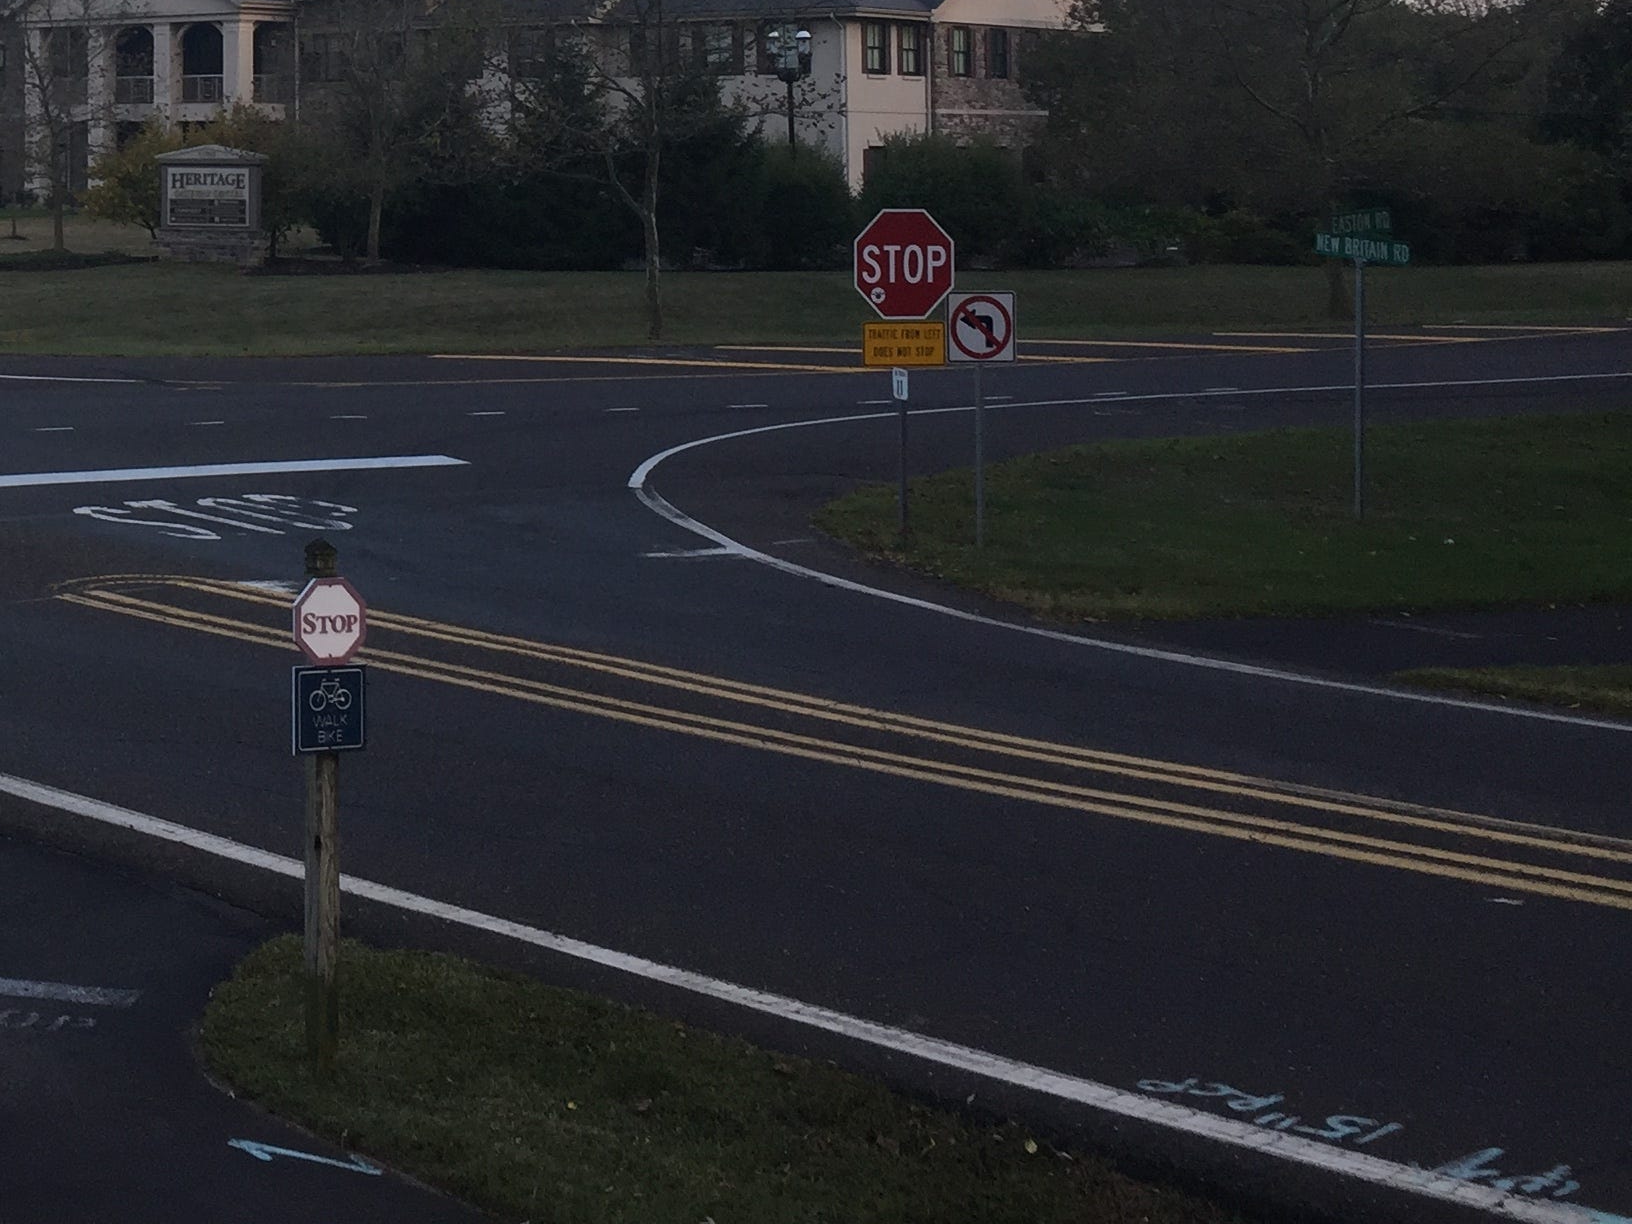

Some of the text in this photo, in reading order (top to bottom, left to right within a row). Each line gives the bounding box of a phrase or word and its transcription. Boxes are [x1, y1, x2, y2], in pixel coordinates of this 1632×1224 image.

[171, 173, 246, 189] HERITAGE
[1331, 210, 1392, 234] EASTON RD
[1316, 233, 1410, 263] NEW BRITAIN RD
[862, 244, 947, 284] STOP
[868, 328, 941, 340] TRAFFIC FROM LEFT
[873, 346, 935, 357] DOES NOT STOP
[302, 612, 358, 635] STOP
[312, 714, 349, 727] WALK
